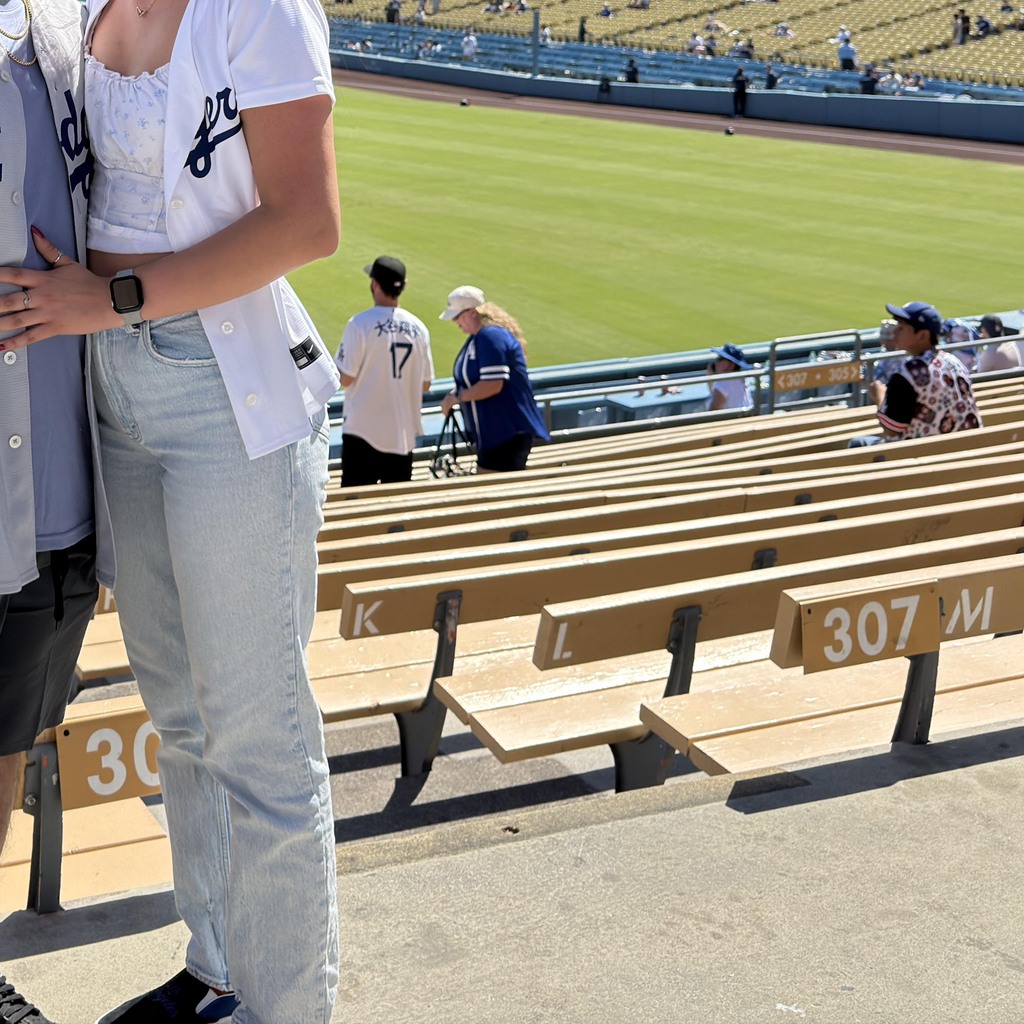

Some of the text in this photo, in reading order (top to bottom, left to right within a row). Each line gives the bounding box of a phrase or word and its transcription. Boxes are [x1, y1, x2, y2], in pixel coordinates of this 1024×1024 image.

[389, 342, 413, 379] 17
[785, 366, 850, 387] 307 305
[353, 600, 384, 636] K
[823, 586, 994, 663] 307 M
[552, 622, 573, 661] L
